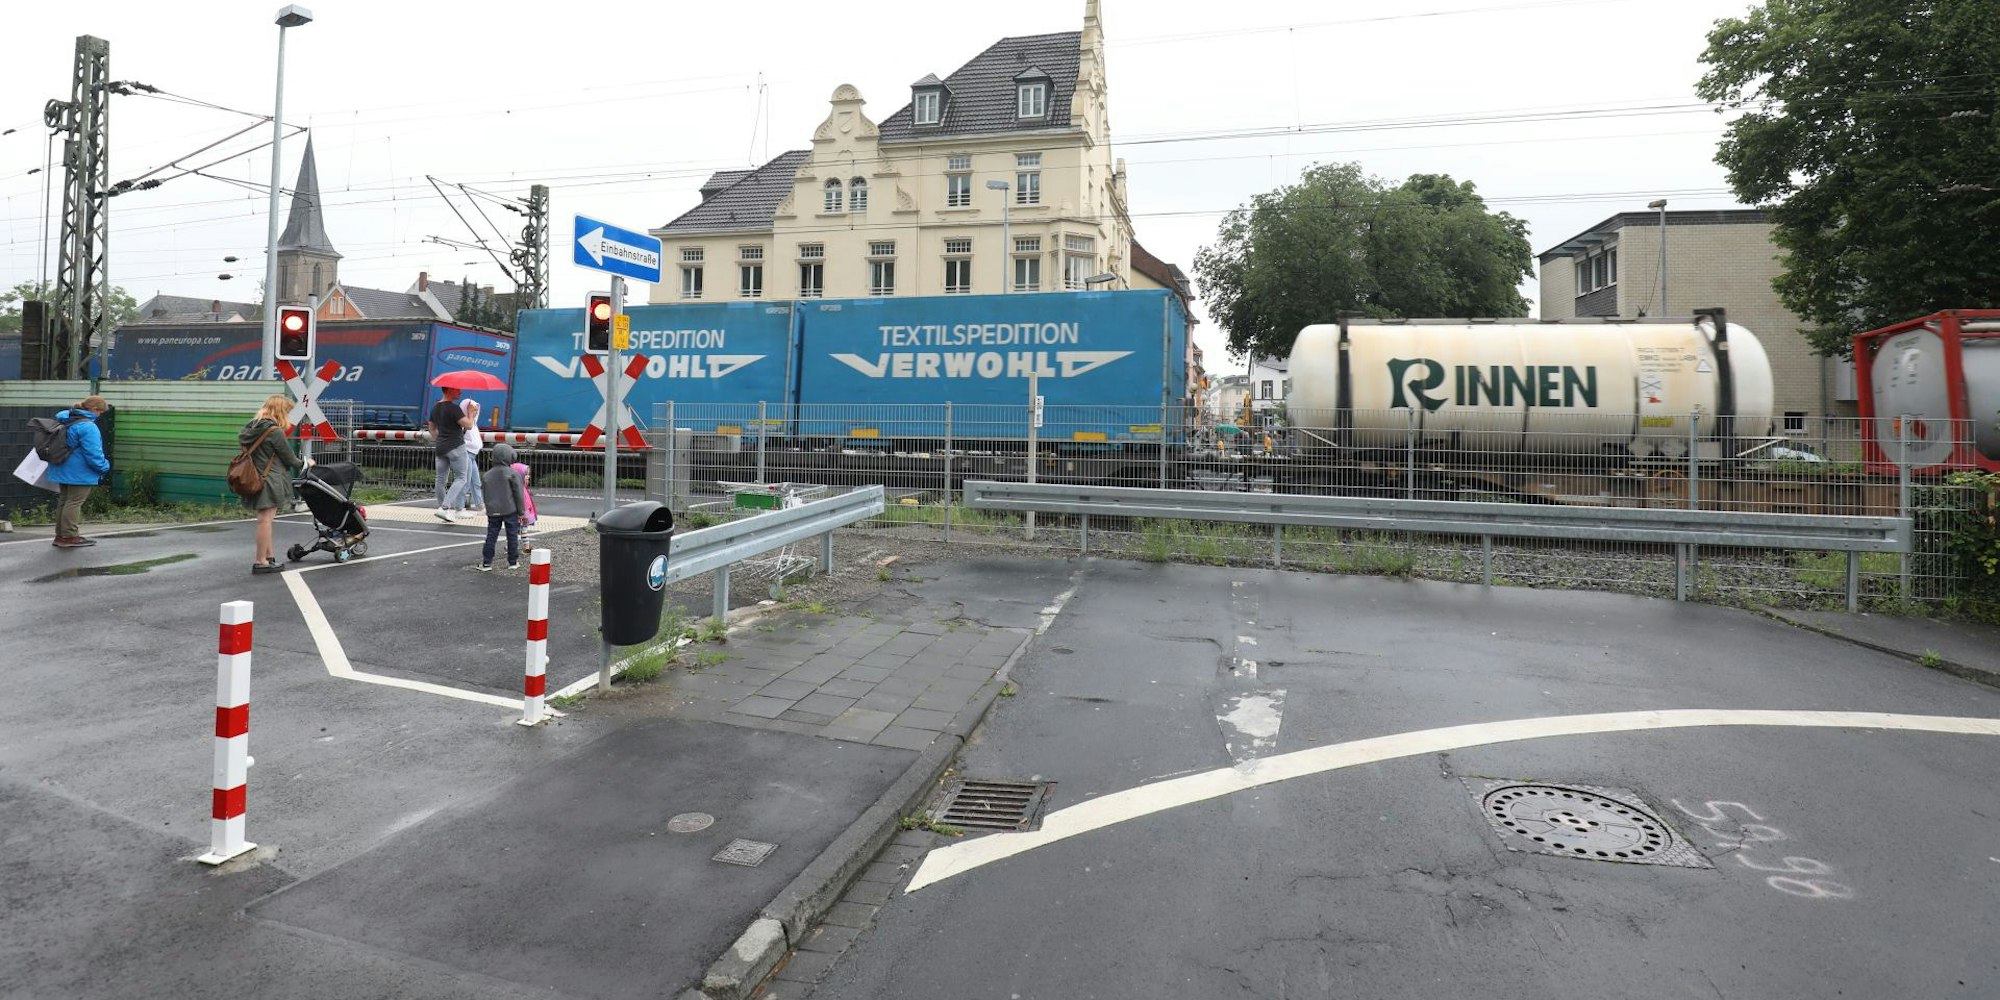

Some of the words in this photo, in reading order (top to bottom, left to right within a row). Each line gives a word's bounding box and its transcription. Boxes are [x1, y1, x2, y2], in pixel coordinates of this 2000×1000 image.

[601, 241, 657, 266] Einbahnstraße
[137, 336, 221, 347] www.paneuropa.com
[572, 329, 725, 350] TSPEDITION
[878, 322, 1079, 347] TEXTILSPEDITION
[446, 352, 500, 368] paneuropa
[531, 354, 767, 378] VOHLT
[1386, 357, 1598, 413] RINNEN
